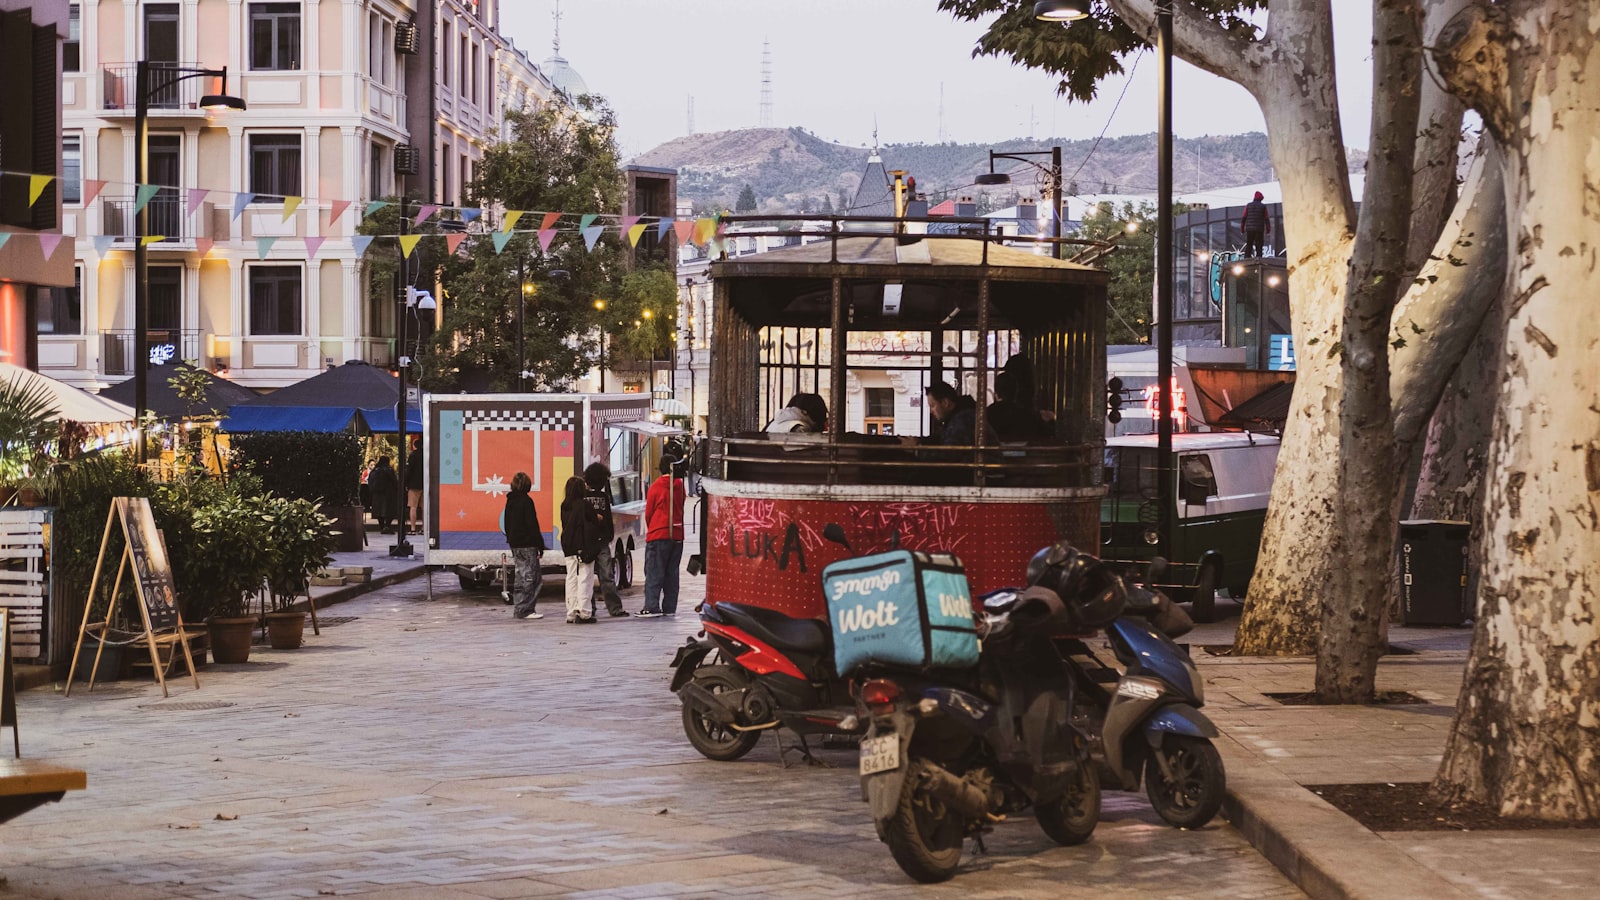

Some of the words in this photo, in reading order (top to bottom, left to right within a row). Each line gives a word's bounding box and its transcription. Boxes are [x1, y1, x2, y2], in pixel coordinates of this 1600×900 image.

[730, 522, 807, 573] LUKA
[838, 600, 899, 634] Wolt
[853, 633, 886, 643] PARTNER
[863, 754, 895, 772] 8416
